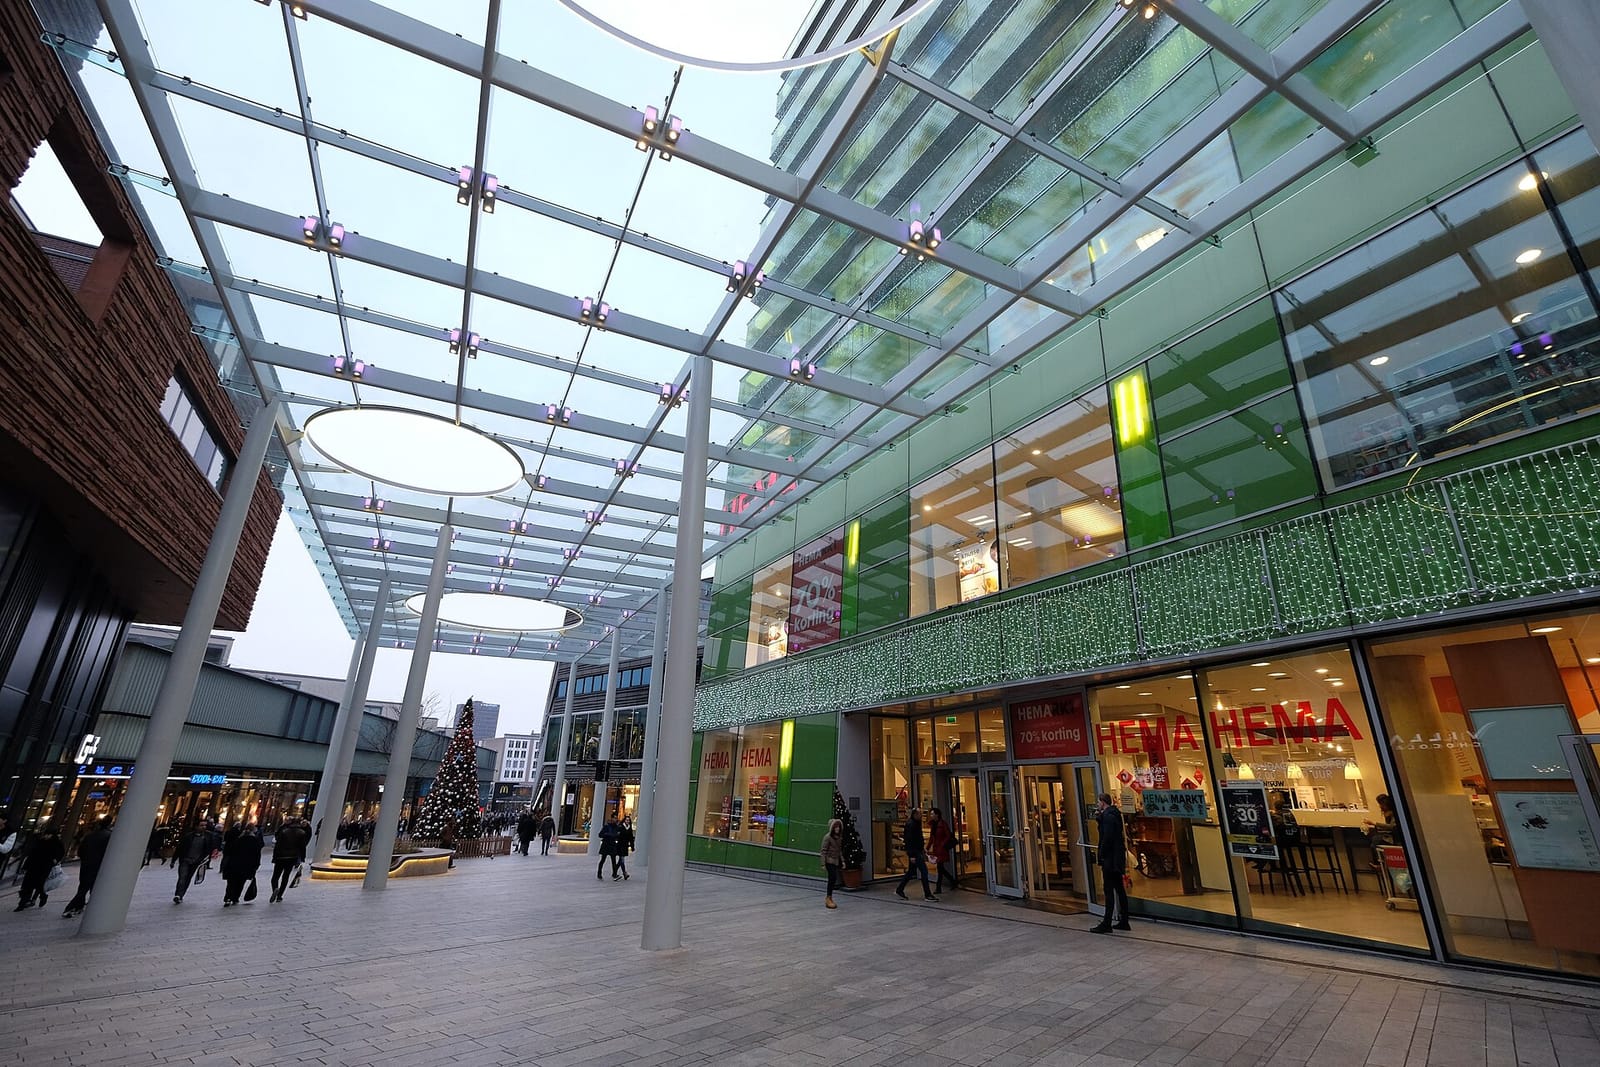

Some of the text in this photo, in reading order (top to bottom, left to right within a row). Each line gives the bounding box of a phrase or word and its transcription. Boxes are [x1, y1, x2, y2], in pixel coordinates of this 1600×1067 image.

[796, 574, 836, 614] 70%
[794, 607, 835, 632] korting
[1209, 697, 1363, 749] HEMA
[1020, 727, 1081, 743] 70% korting
[1095, 715, 1199, 755] HEMA
[703, 748, 772, 769] HEMA HEMA
[1143, 793, 1170, 803] HEMA
[1170, 793, 1204, 804] MARKT
[1237, 807, 1258, 822] 30
